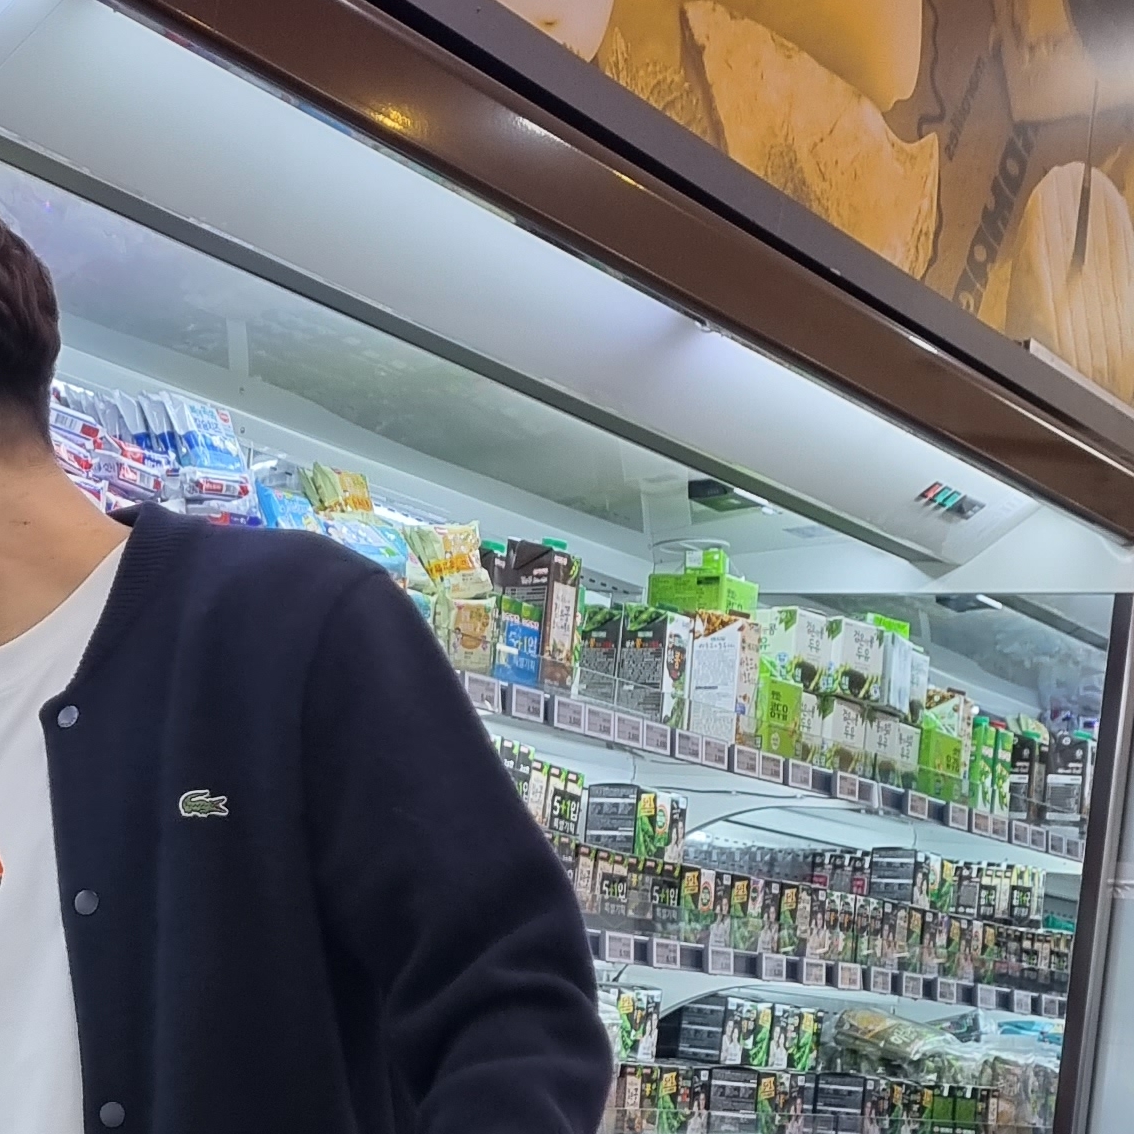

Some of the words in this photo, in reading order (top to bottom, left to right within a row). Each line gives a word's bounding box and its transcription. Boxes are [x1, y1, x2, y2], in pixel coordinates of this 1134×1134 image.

[552, 795, 580, 821] 5+1입
[602, 880, 627, 902] 5+1입
[652, 885, 679, 908] 5+1입
